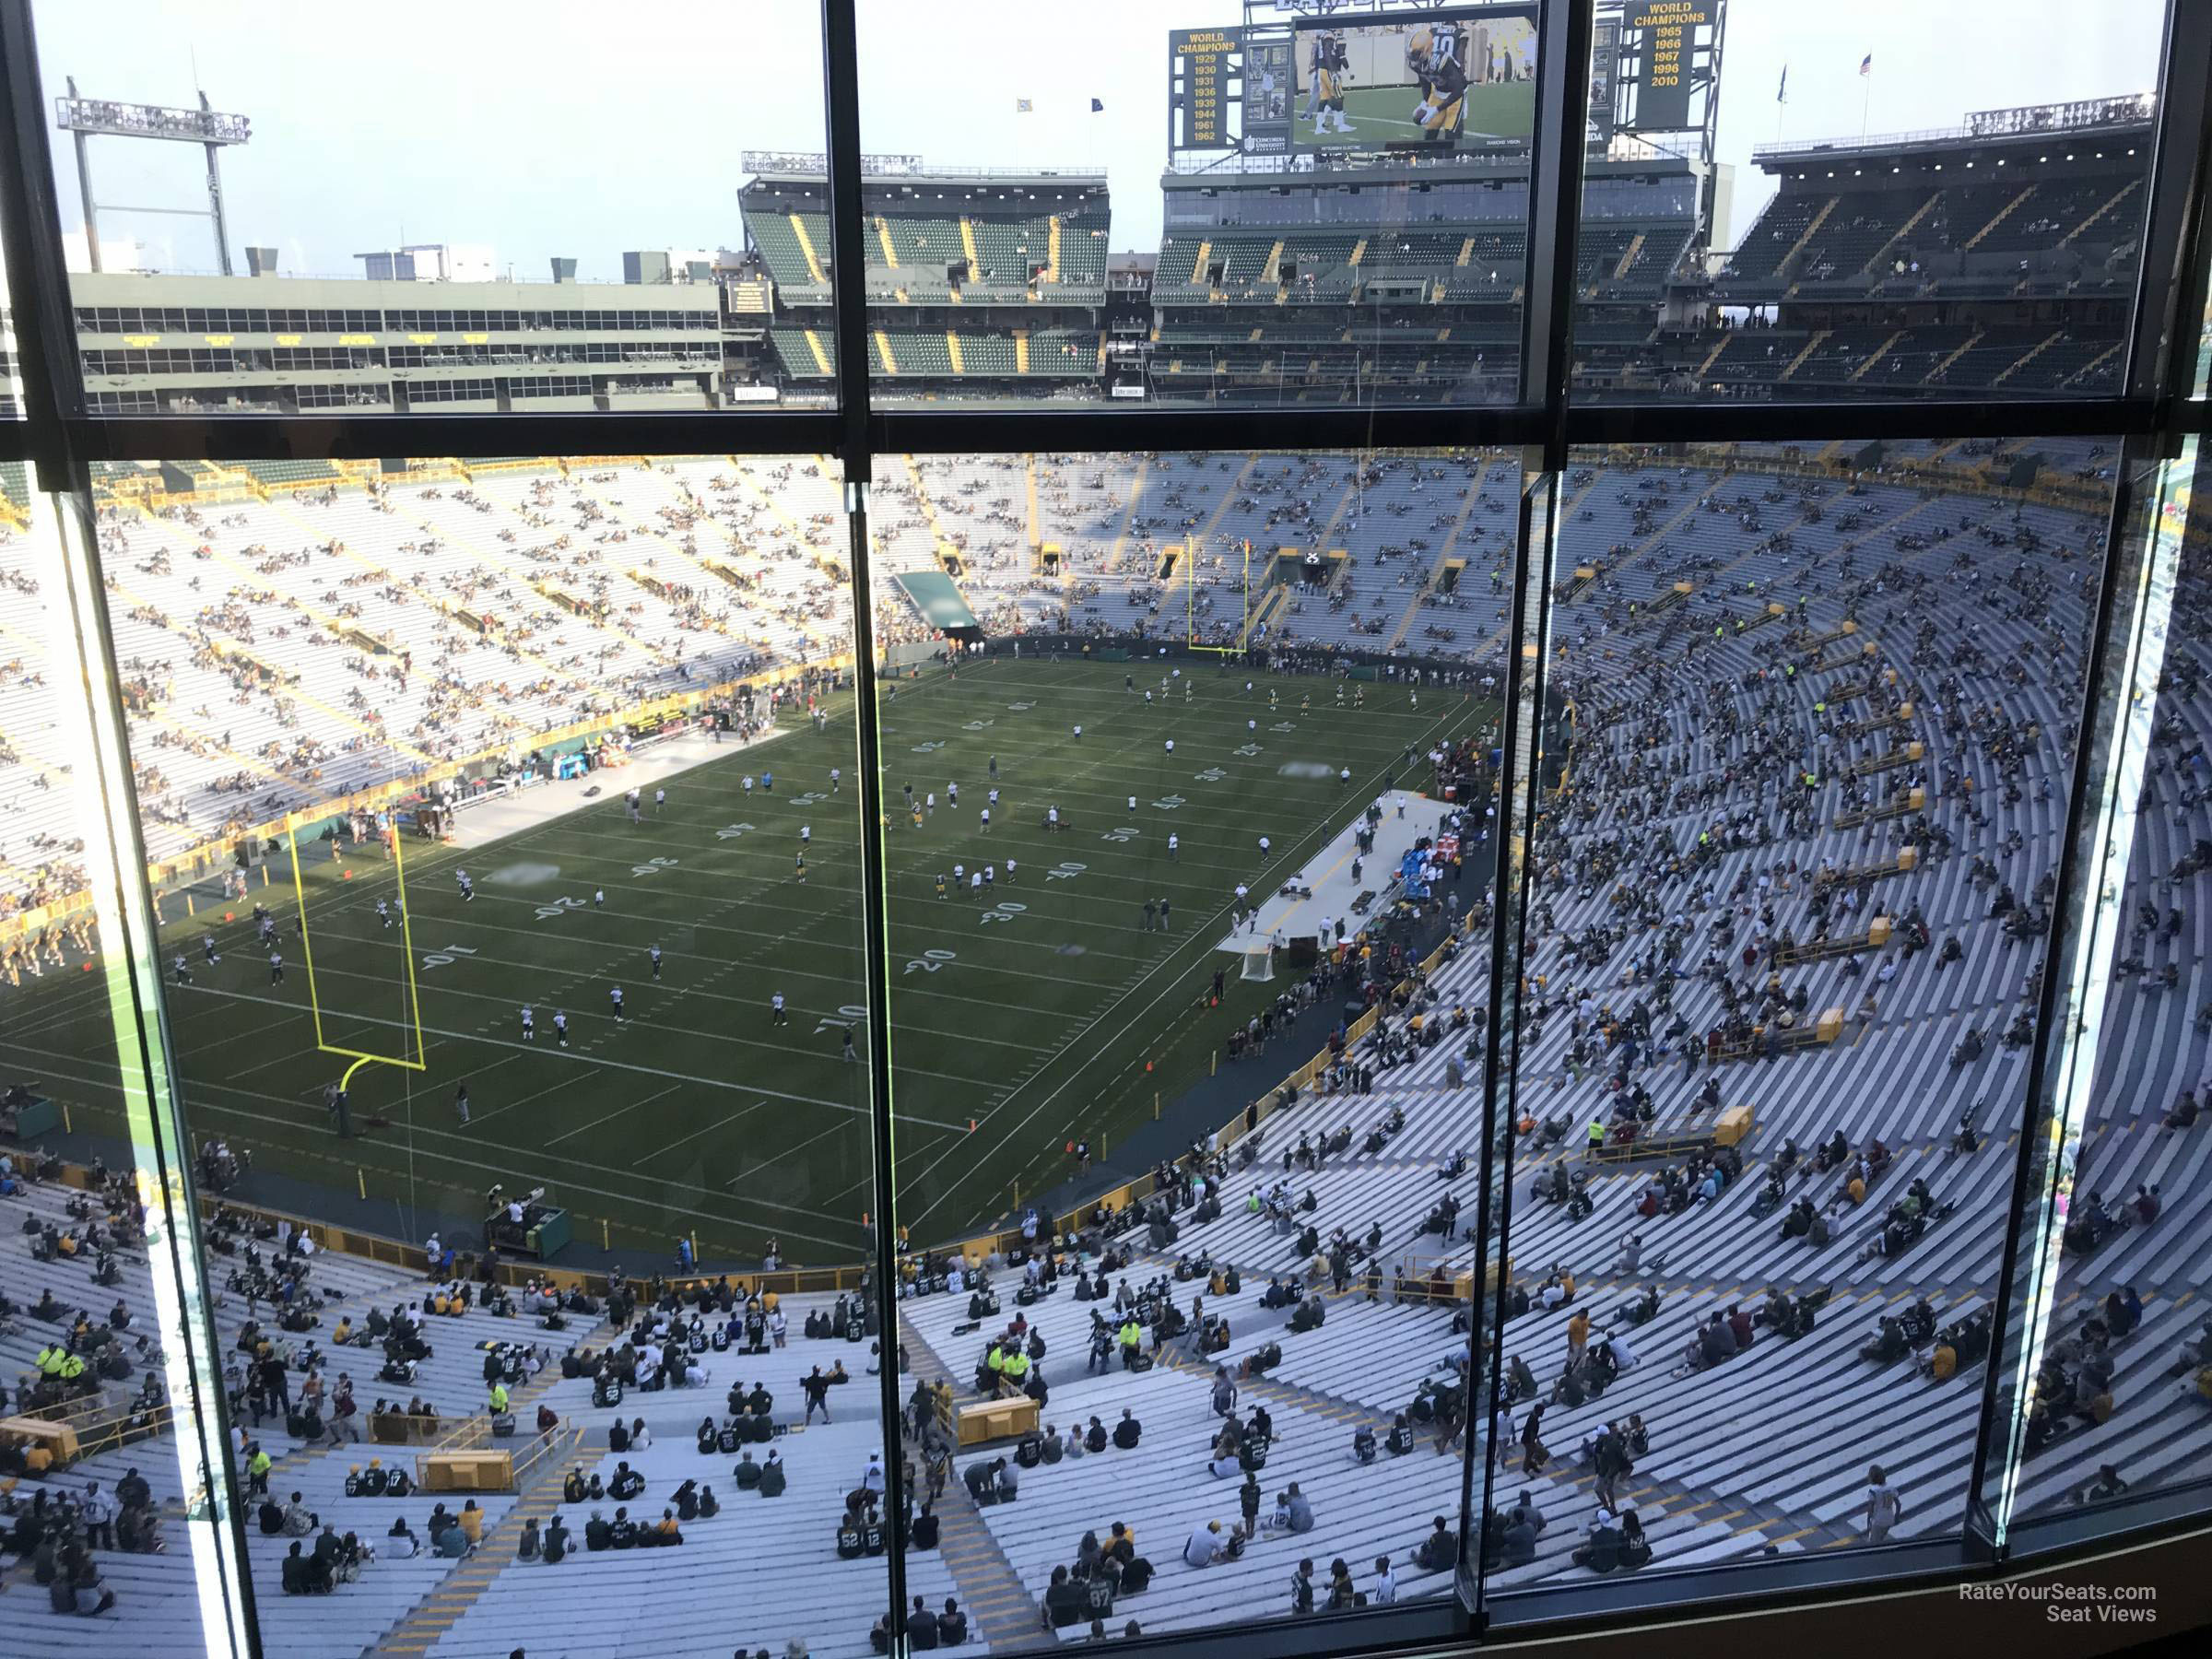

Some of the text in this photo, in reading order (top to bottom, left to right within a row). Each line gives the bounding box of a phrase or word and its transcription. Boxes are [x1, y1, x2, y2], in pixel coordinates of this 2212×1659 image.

[1650, 2, 1691, 14] WORLD
[1634, 12, 1705, 26] CHAMPIONS
[1656, 26, 1681, 37] 1965
[1190, 33, 1224, 43] WORLD
[1178, 42, 1235, 53] CHAMPIONS
[1655, 39, 1681, 50] 1966
[1194, 54, 1216, 64] 1929
[1654, 52, 1679, 62] 1967
[1194, 66, 1217, 75] 1930
[1653, 64, 1679, 74] 1996
[1194, 77, 1213, 86] 1931
[1652, 76, 1678, 87] 2010
[1307, 553, 1318, 562] 25
[1100, 828, 1140, 842] 50
[1048, 863, 1088, 879] 40
[535, 896, 586, 916] 20
[982, 902, 1028, 922] 30
[424, 944, 477, 968] 10
[905, 949, 957, 973] 20
[850, 1327, 859, 1338] 15
[717, 1333, 726, 1346] 12
[505, 1362, 514, 1373] 12
[1401, 1433, 1412, 1447] 12
[1025, 1446, 1038, 1460] 12
[390, 1475, 401, 1488] 17
[1275, 1512, 1288, 1524] 12
[841, 1533, 859, 1547] 52
[868, 1534, 879, 1547] 12
[1089, 1588, 1110, 1607] 87
